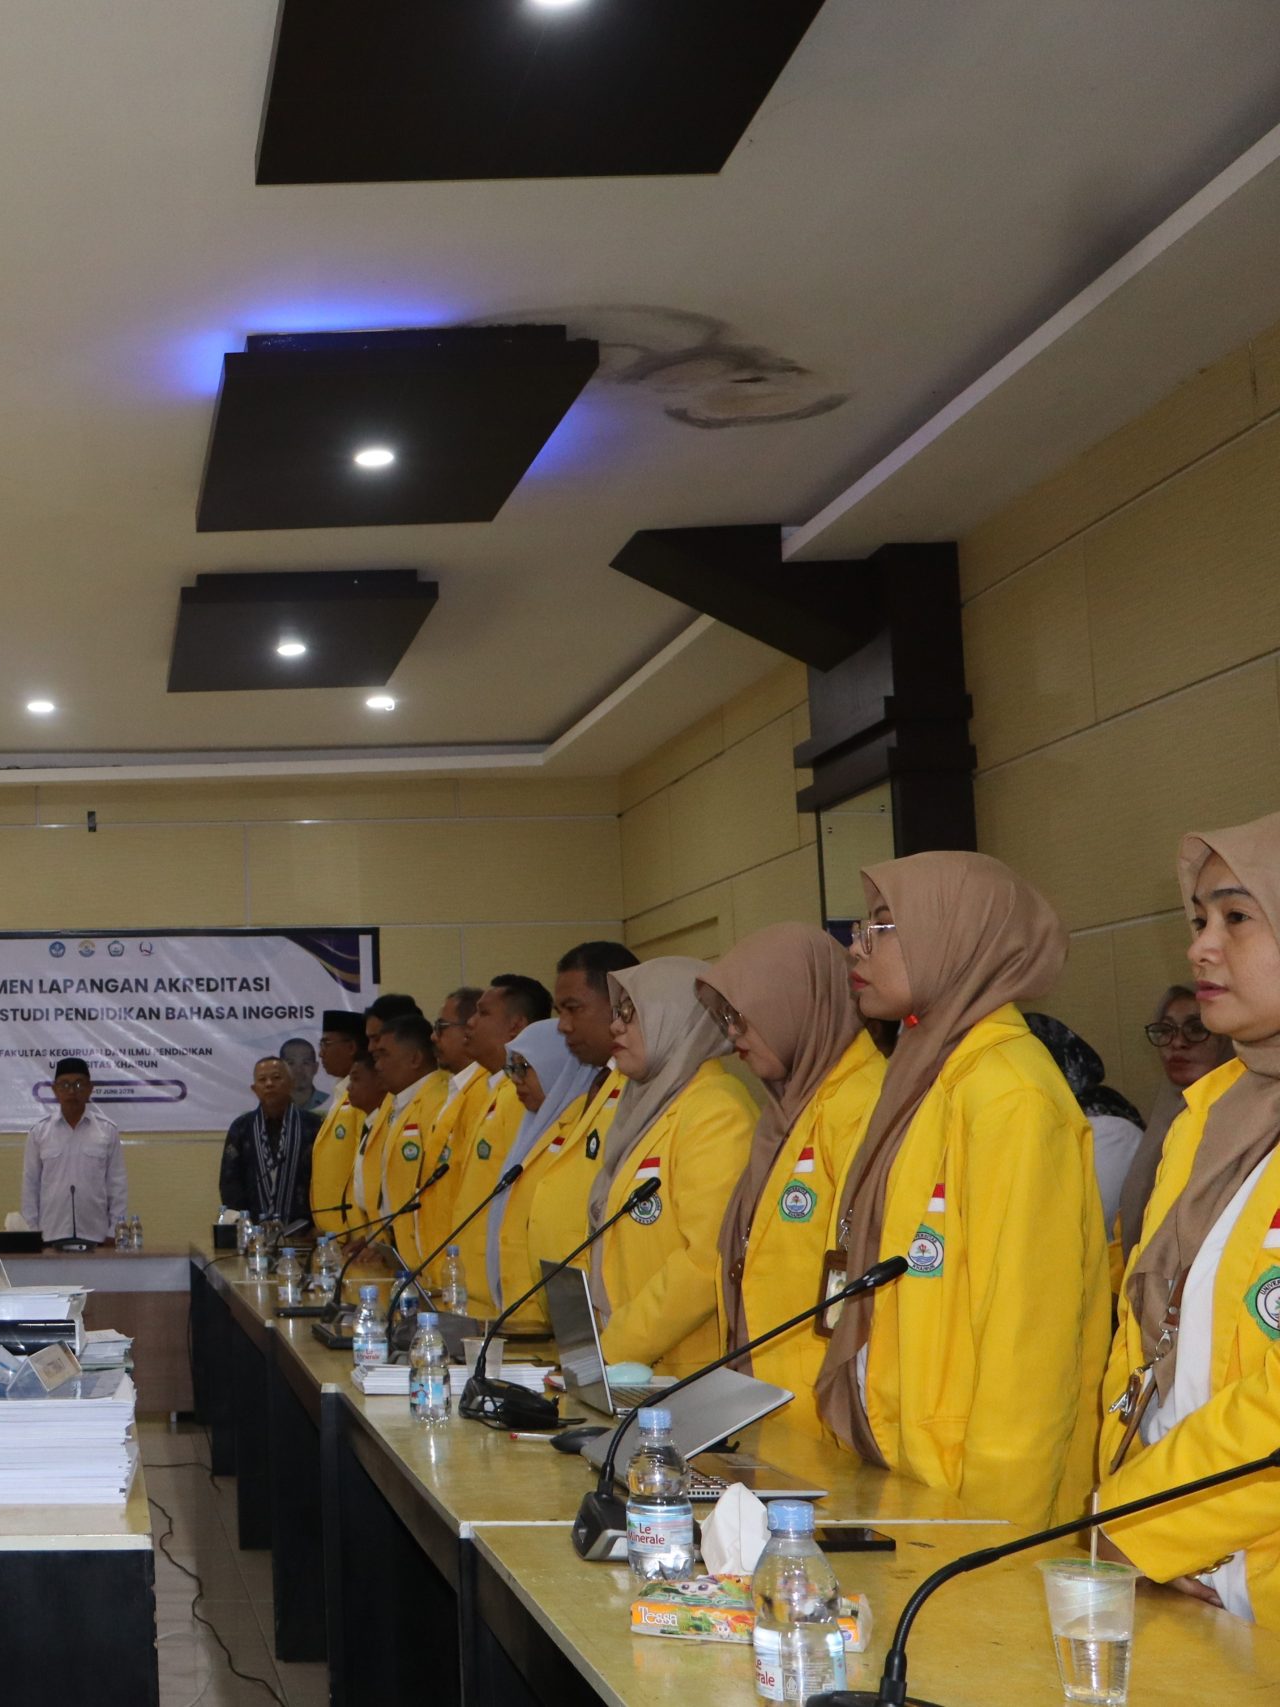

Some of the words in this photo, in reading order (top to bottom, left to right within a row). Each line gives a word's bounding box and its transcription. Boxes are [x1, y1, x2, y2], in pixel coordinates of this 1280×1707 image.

[38, 978, 148, 994] LAPANGAN
[153, 976, 270, 993] AKREDITASI
[0, 1008, 49, 1022] STUDI
[54, 1006, 161, 1022] PENDIDIKAN
[165, 1006, 239, 1021] BAHASA
[243, 1005, 315, 1020] INGGRIS
[0, 1049, 47, 1057] FAKULTAS
[128, 1048, 151, 1056] ILMU
[115, 1060, 158, 1069] KHARUN
[639, 1522, 651, 1534] Le
[627, 1530, 665, 1545] Minerale
[638, 1605, 678, 1627] Tessa
